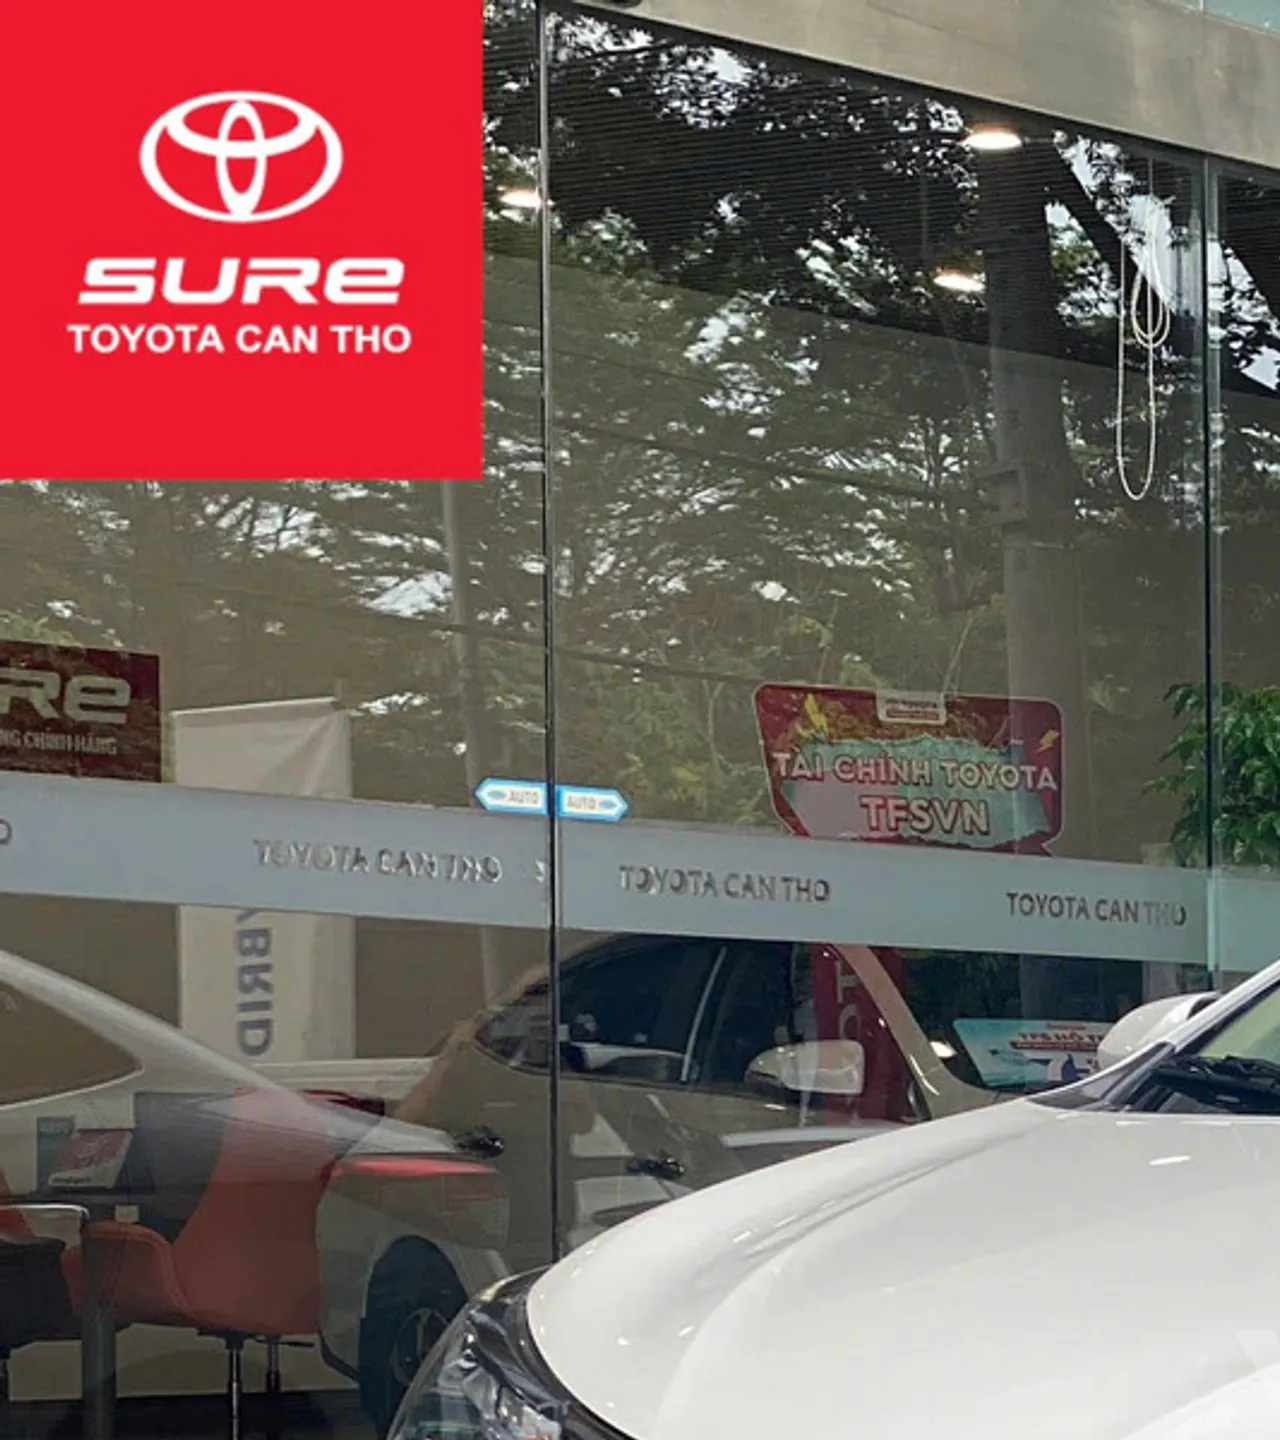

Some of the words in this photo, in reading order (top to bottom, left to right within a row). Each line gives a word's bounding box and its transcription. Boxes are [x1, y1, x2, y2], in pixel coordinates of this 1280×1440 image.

[834, 752, 933, 786] CHÍNH
[940, 760, 1057, 791] TOYOTA
[509, 790, 540, 806] AUTO
[566, 794, 597, 810] AUTO
[860, 795, 990, 835] TFSVN
[619, 864, 718, 898] TOYOTA
[724, 872, 776, 901] CAN
[781, 876, 832, 903] THO
[1006, 891, 1091, 922] TOYOTA
[1094, 897, 1139, 924] CAN
